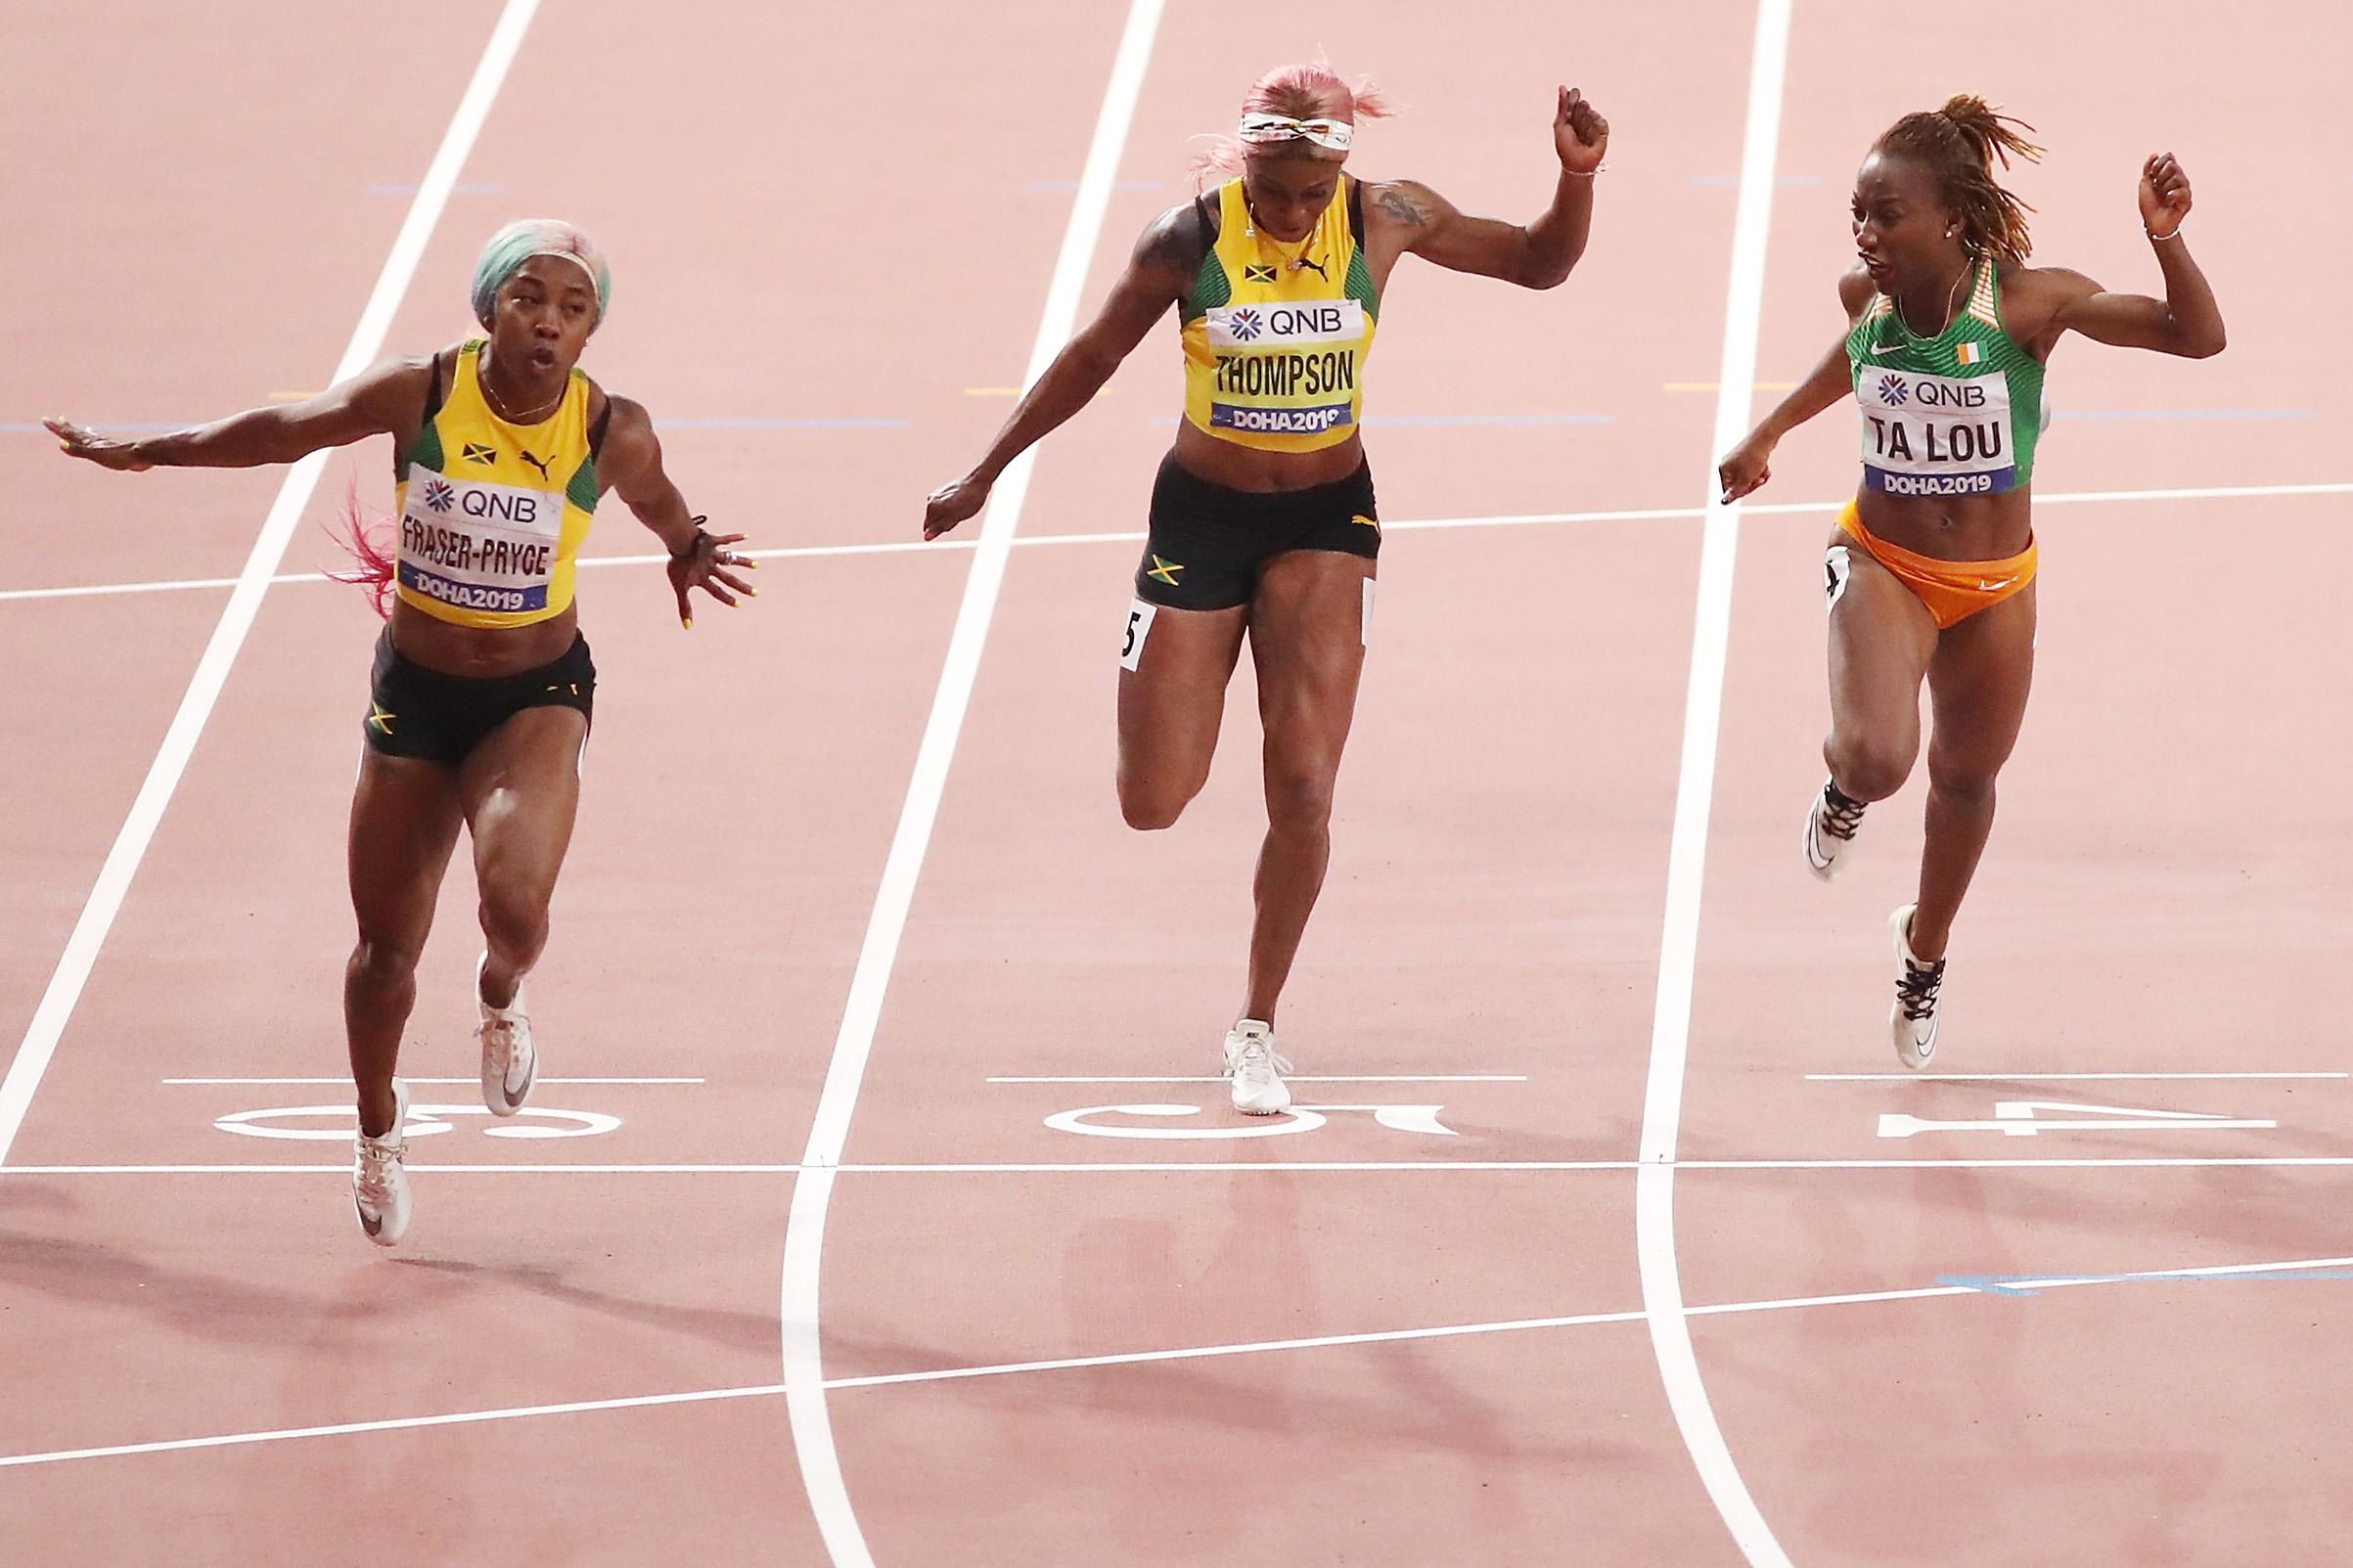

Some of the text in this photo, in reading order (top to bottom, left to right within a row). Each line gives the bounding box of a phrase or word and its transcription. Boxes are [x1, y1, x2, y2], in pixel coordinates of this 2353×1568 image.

[1270, 308, 1342, 336] QNB
[1215, 349, 1354, 396] THOMPSON
[1915, 381, 1986, 408] QNB
[1233, 409, 1339, 431] DOHA2019
[1868, 416, 2002, 462] TA LOU
[1884, 473, 1992, 495] DOHA2019
[462, 489, 537, 523] QNB
[402, 515, 550, 576] FRASER-PRYCE
[417, 573, 524, 609] DOHA2019
[1121, 611, 1142, 657] 5
[1043, 1103, 1460, 1139] 5
[1878, 1101, 2278, 1138] 4
